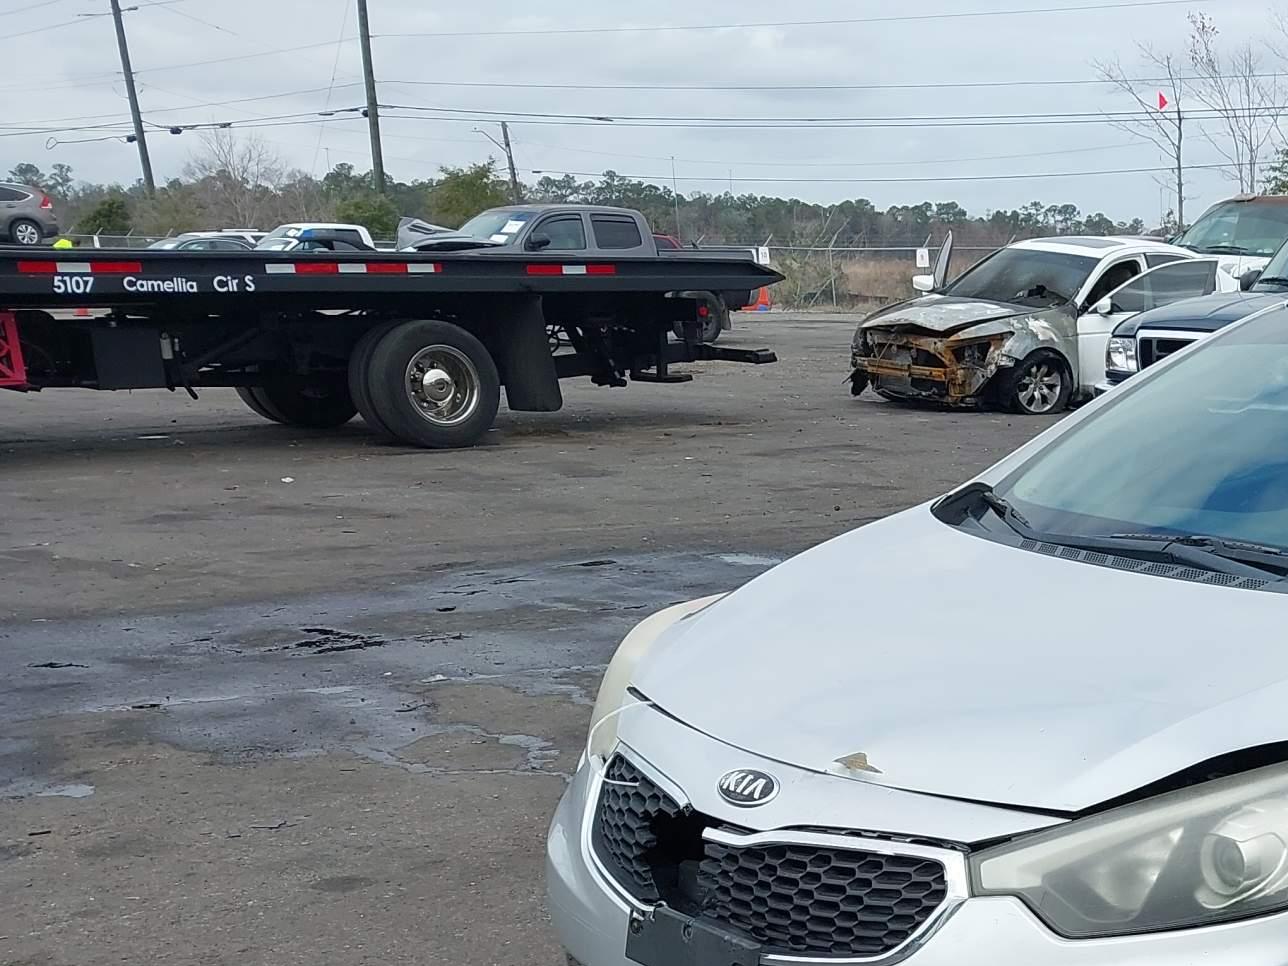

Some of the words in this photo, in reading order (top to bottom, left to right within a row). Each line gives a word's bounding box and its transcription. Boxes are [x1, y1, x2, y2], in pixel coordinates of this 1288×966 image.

[53, 276, 94, 294] 5107
[123, 276, 198, 293] Camellia
[213, 275, 239, 292] Cir
[244, 275, 256, 292] S
[722, 771, 767, 800] KIA
